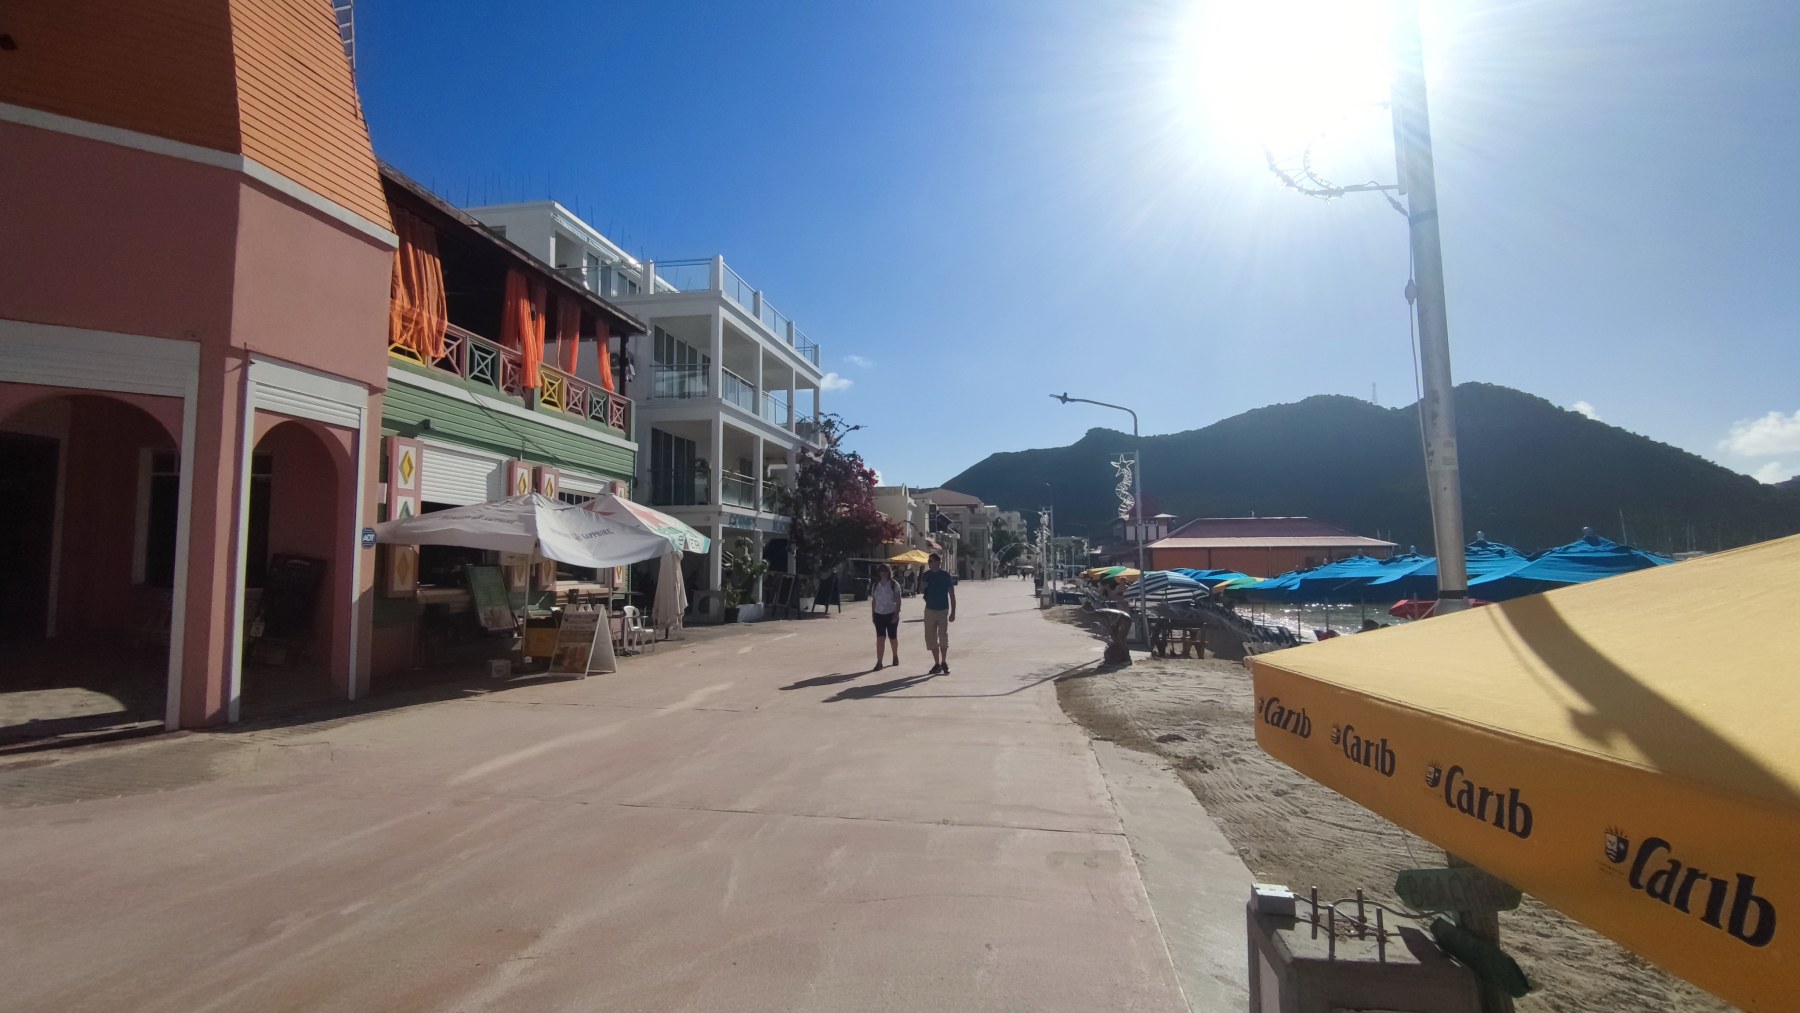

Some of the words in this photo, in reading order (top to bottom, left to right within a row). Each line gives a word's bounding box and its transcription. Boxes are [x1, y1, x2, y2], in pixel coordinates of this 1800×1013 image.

[362, 533, 375, 542] ADT
[581, 528, 614, 540] SAPPHIRE
[1264, 697, 1312, 739] Carib
[1342, 724, 1396, 778] Carib
[1444, 765, 1533, 839] Carib
[1628, 836, 1777, 948] Carib
